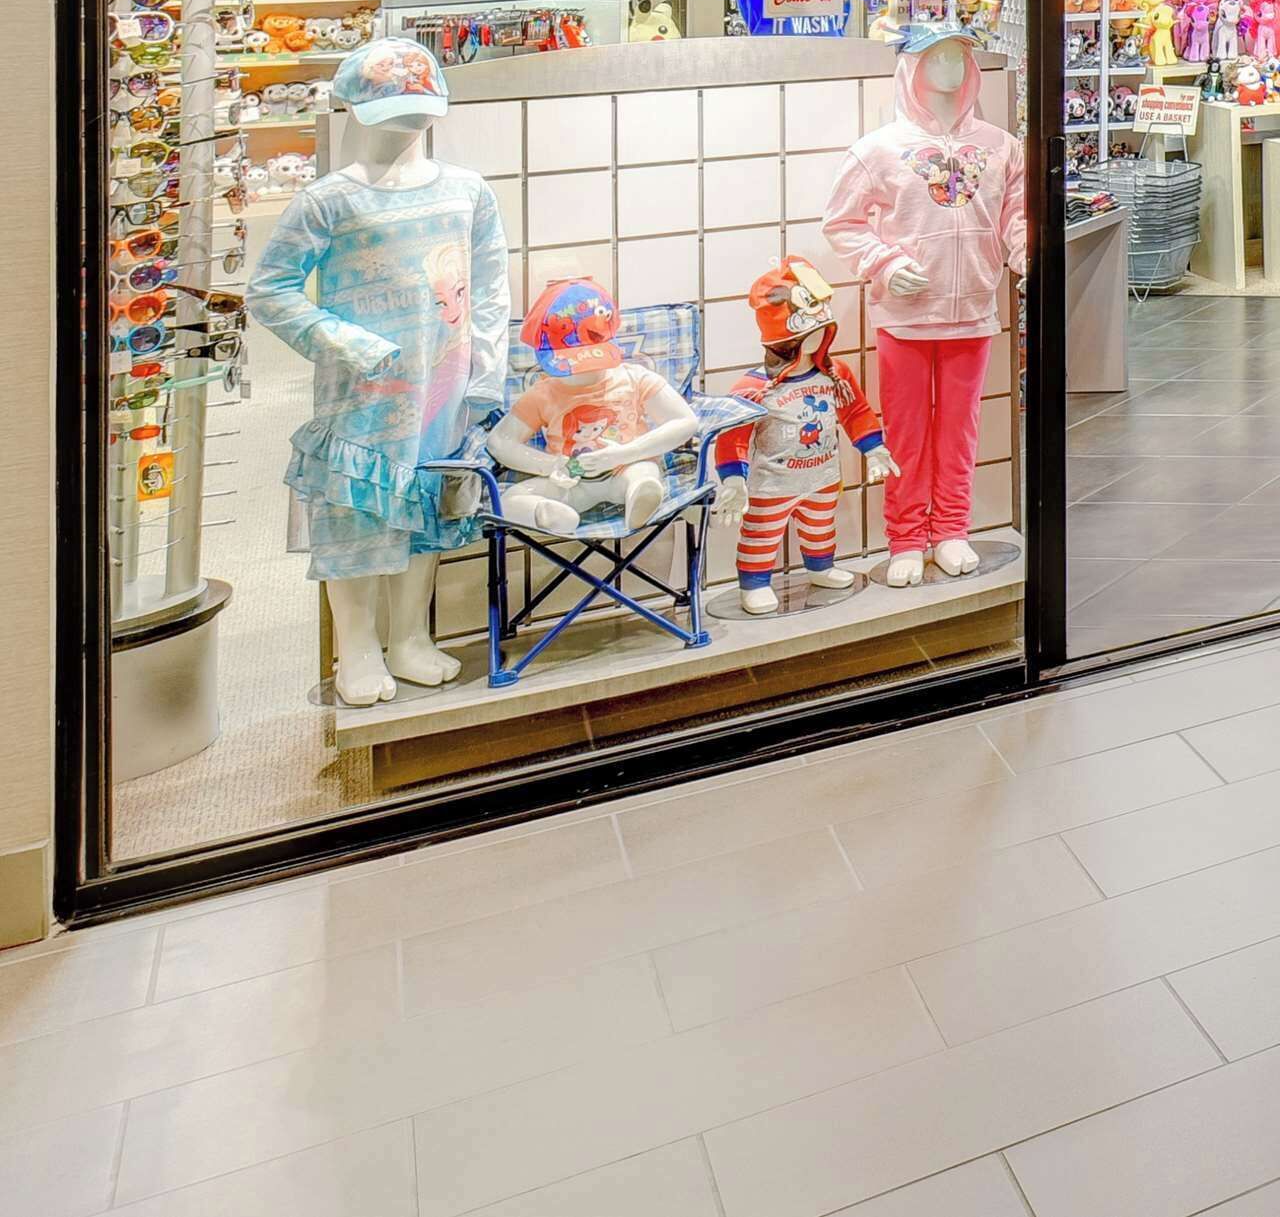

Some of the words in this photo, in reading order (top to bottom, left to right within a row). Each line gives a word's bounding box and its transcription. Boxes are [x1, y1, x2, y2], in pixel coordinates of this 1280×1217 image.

[772, 17, 787, 34] IT
[1139, 111, 1155, 121] USE
[786, 450, 835, 470] ORIGINAL
